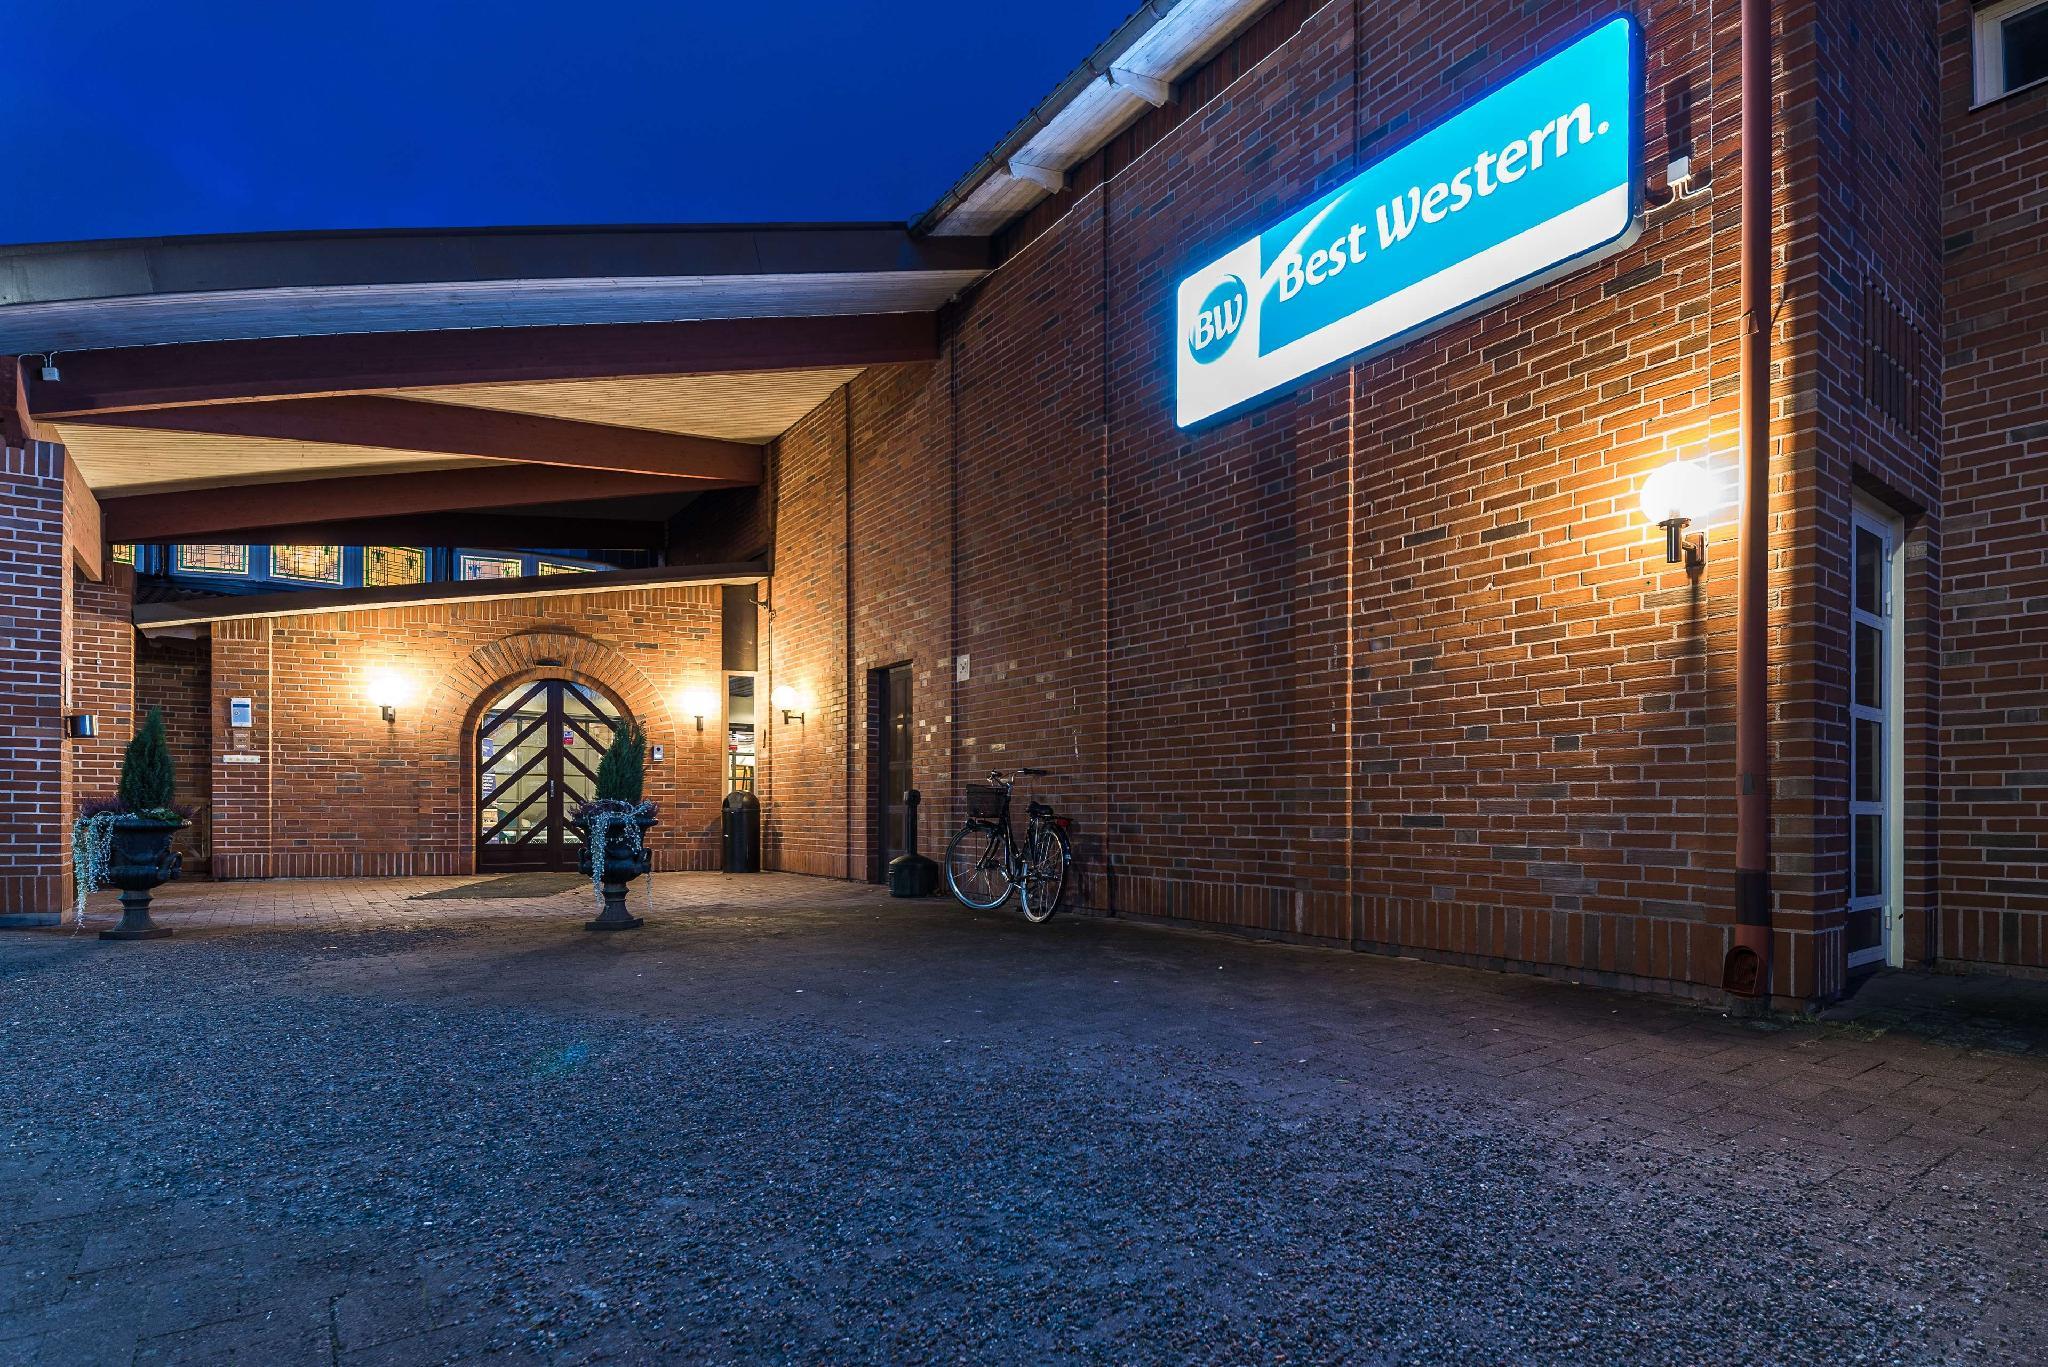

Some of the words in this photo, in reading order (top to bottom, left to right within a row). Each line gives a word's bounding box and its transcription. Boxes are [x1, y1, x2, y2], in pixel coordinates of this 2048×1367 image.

[1279, 223, 1367, 302] Best
[1375, 102, 1610, 250] Western.
[1195, 293, 1243, 351] BW
